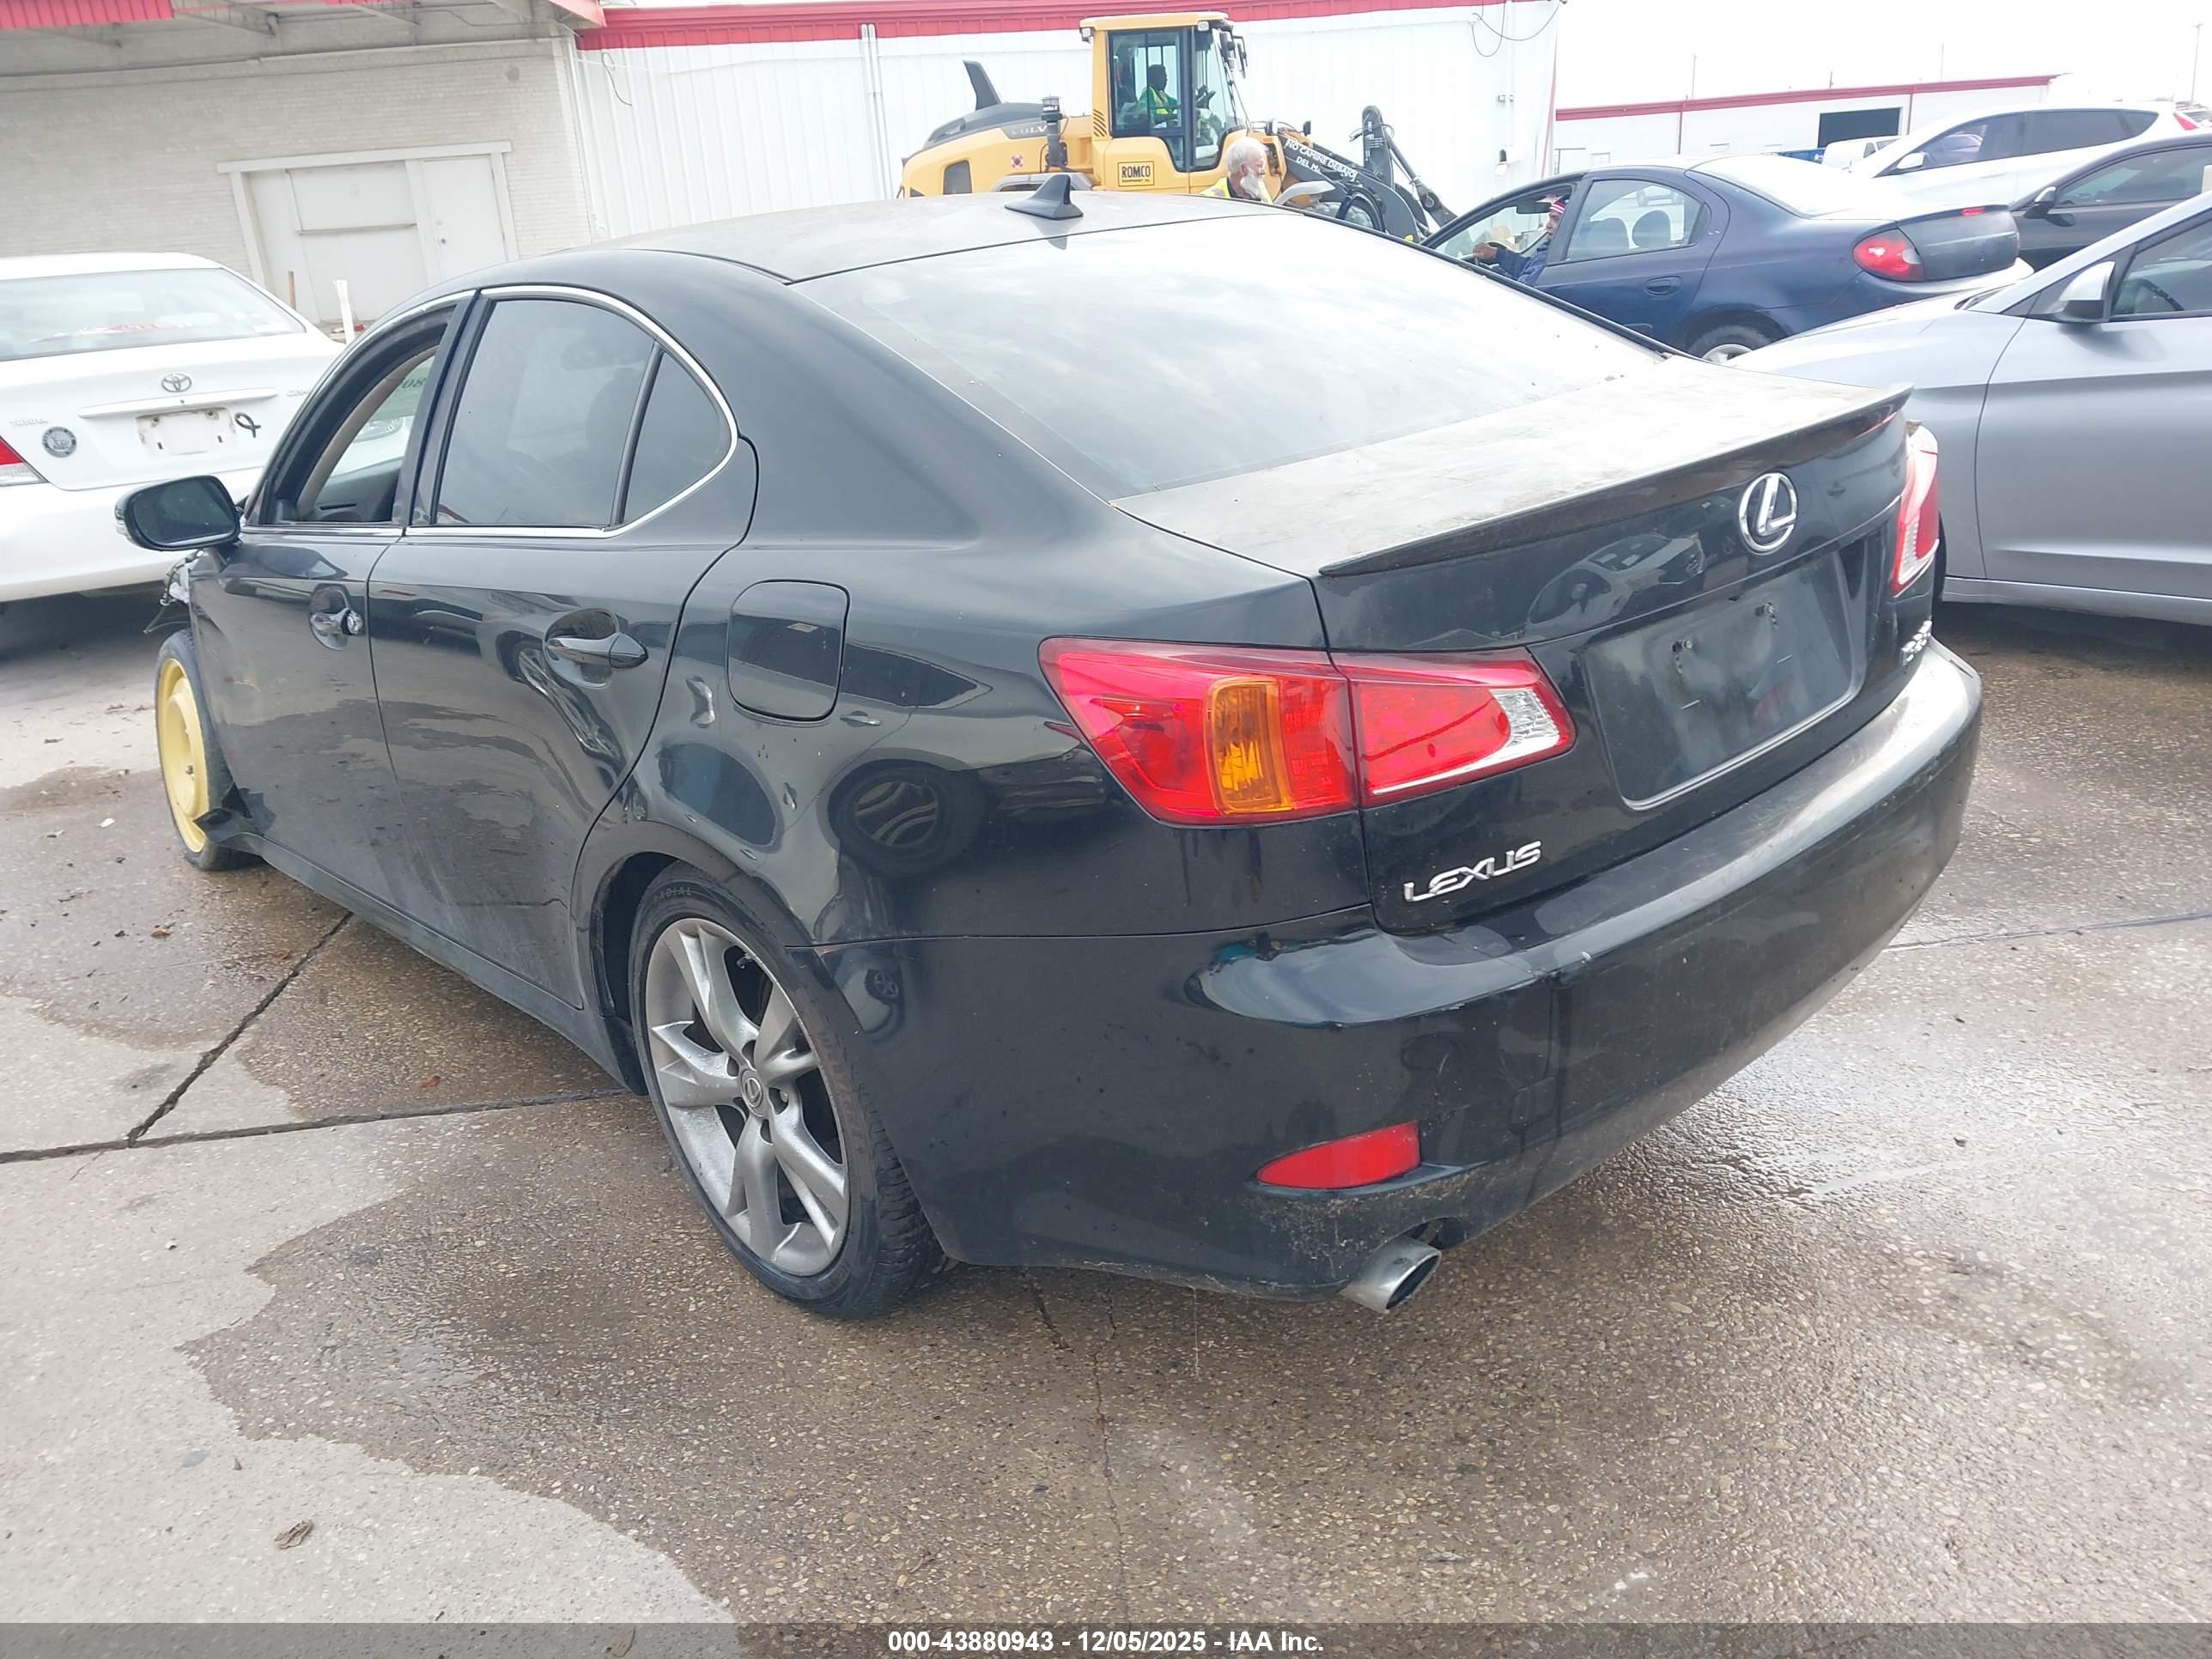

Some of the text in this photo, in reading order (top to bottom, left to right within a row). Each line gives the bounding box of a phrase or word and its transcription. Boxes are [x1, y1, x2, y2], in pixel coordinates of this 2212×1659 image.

[1011, 125, 1048, 135] VOLV
[1297, 156, 1310, 167] DEL
[1121, 165, 1151, 179] ROMCO
[1402, 840, 1543, 902] LEXUS
